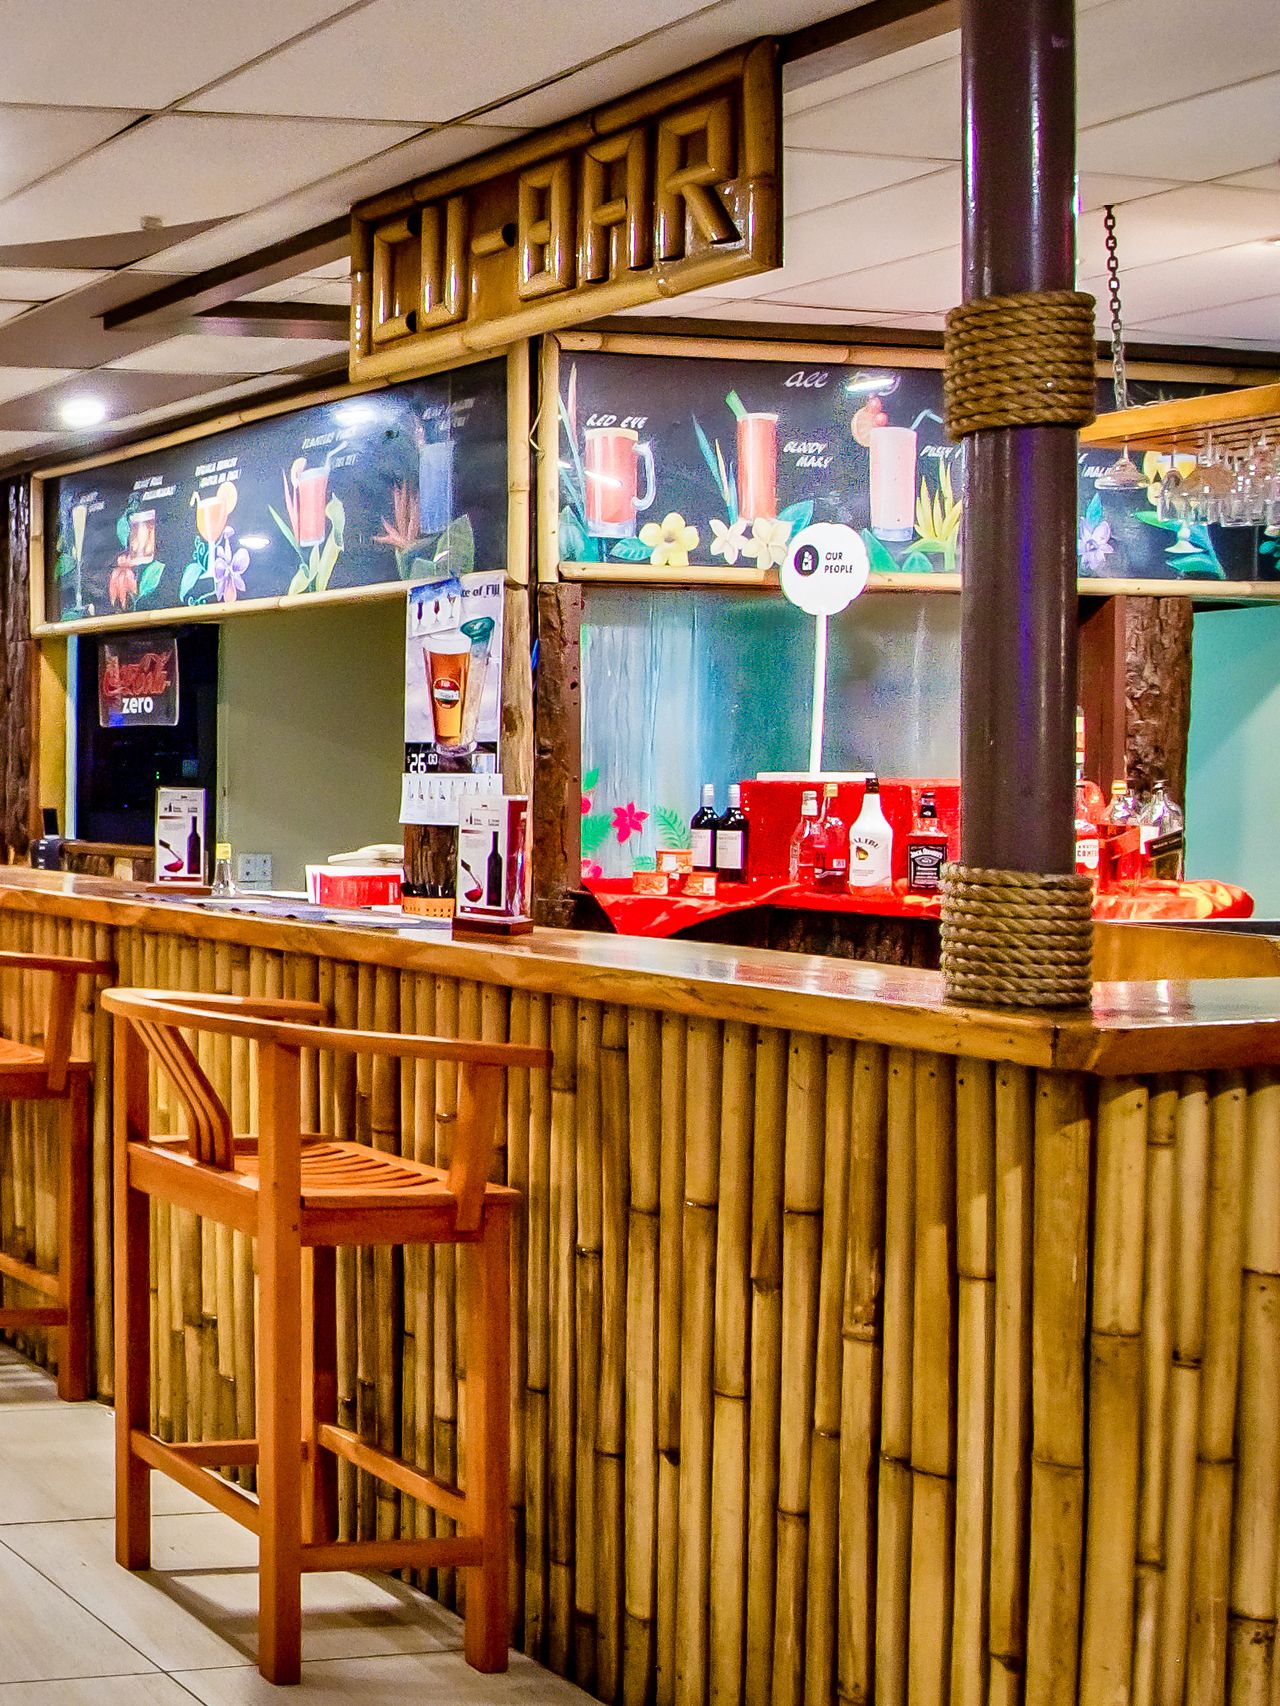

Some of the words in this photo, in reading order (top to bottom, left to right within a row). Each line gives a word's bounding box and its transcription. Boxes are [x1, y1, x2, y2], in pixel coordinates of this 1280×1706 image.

[374, 99, 742, 344] CU-BAR
[783, 441, 827, 455] BLOODY
[825, 552, 843, 561] OUR
[824, 564, 853, 574] PEOPLE
[121, 697, 153, 714] zero
